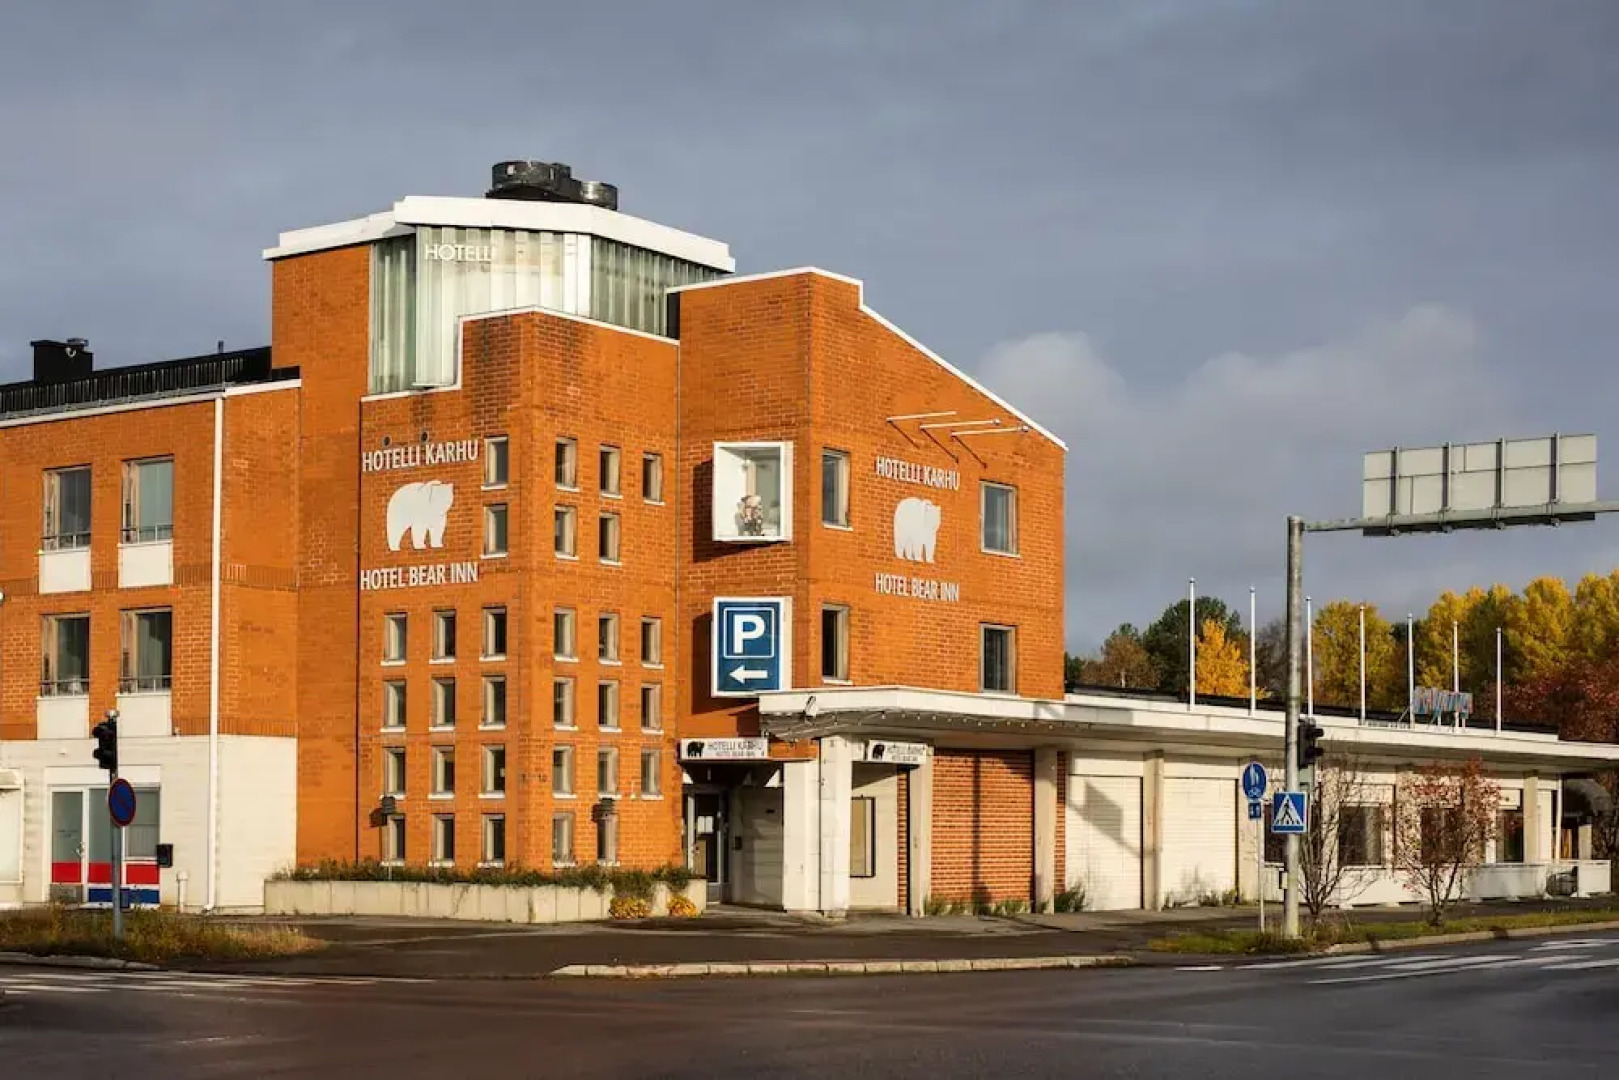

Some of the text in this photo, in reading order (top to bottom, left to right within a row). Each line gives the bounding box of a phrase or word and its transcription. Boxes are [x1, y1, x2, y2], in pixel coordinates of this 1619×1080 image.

[362, 440, 479, 471] HOTELLI KARHU
[876, 455, 960, 491] HOTELLI KARHU
[361, 562, 478, 590] HOTEL BEAR INN
[875, 573, 908, 596] HOTEL
[911, 577, 938, 600] BEAR
[733, 614, 765, 654] P
